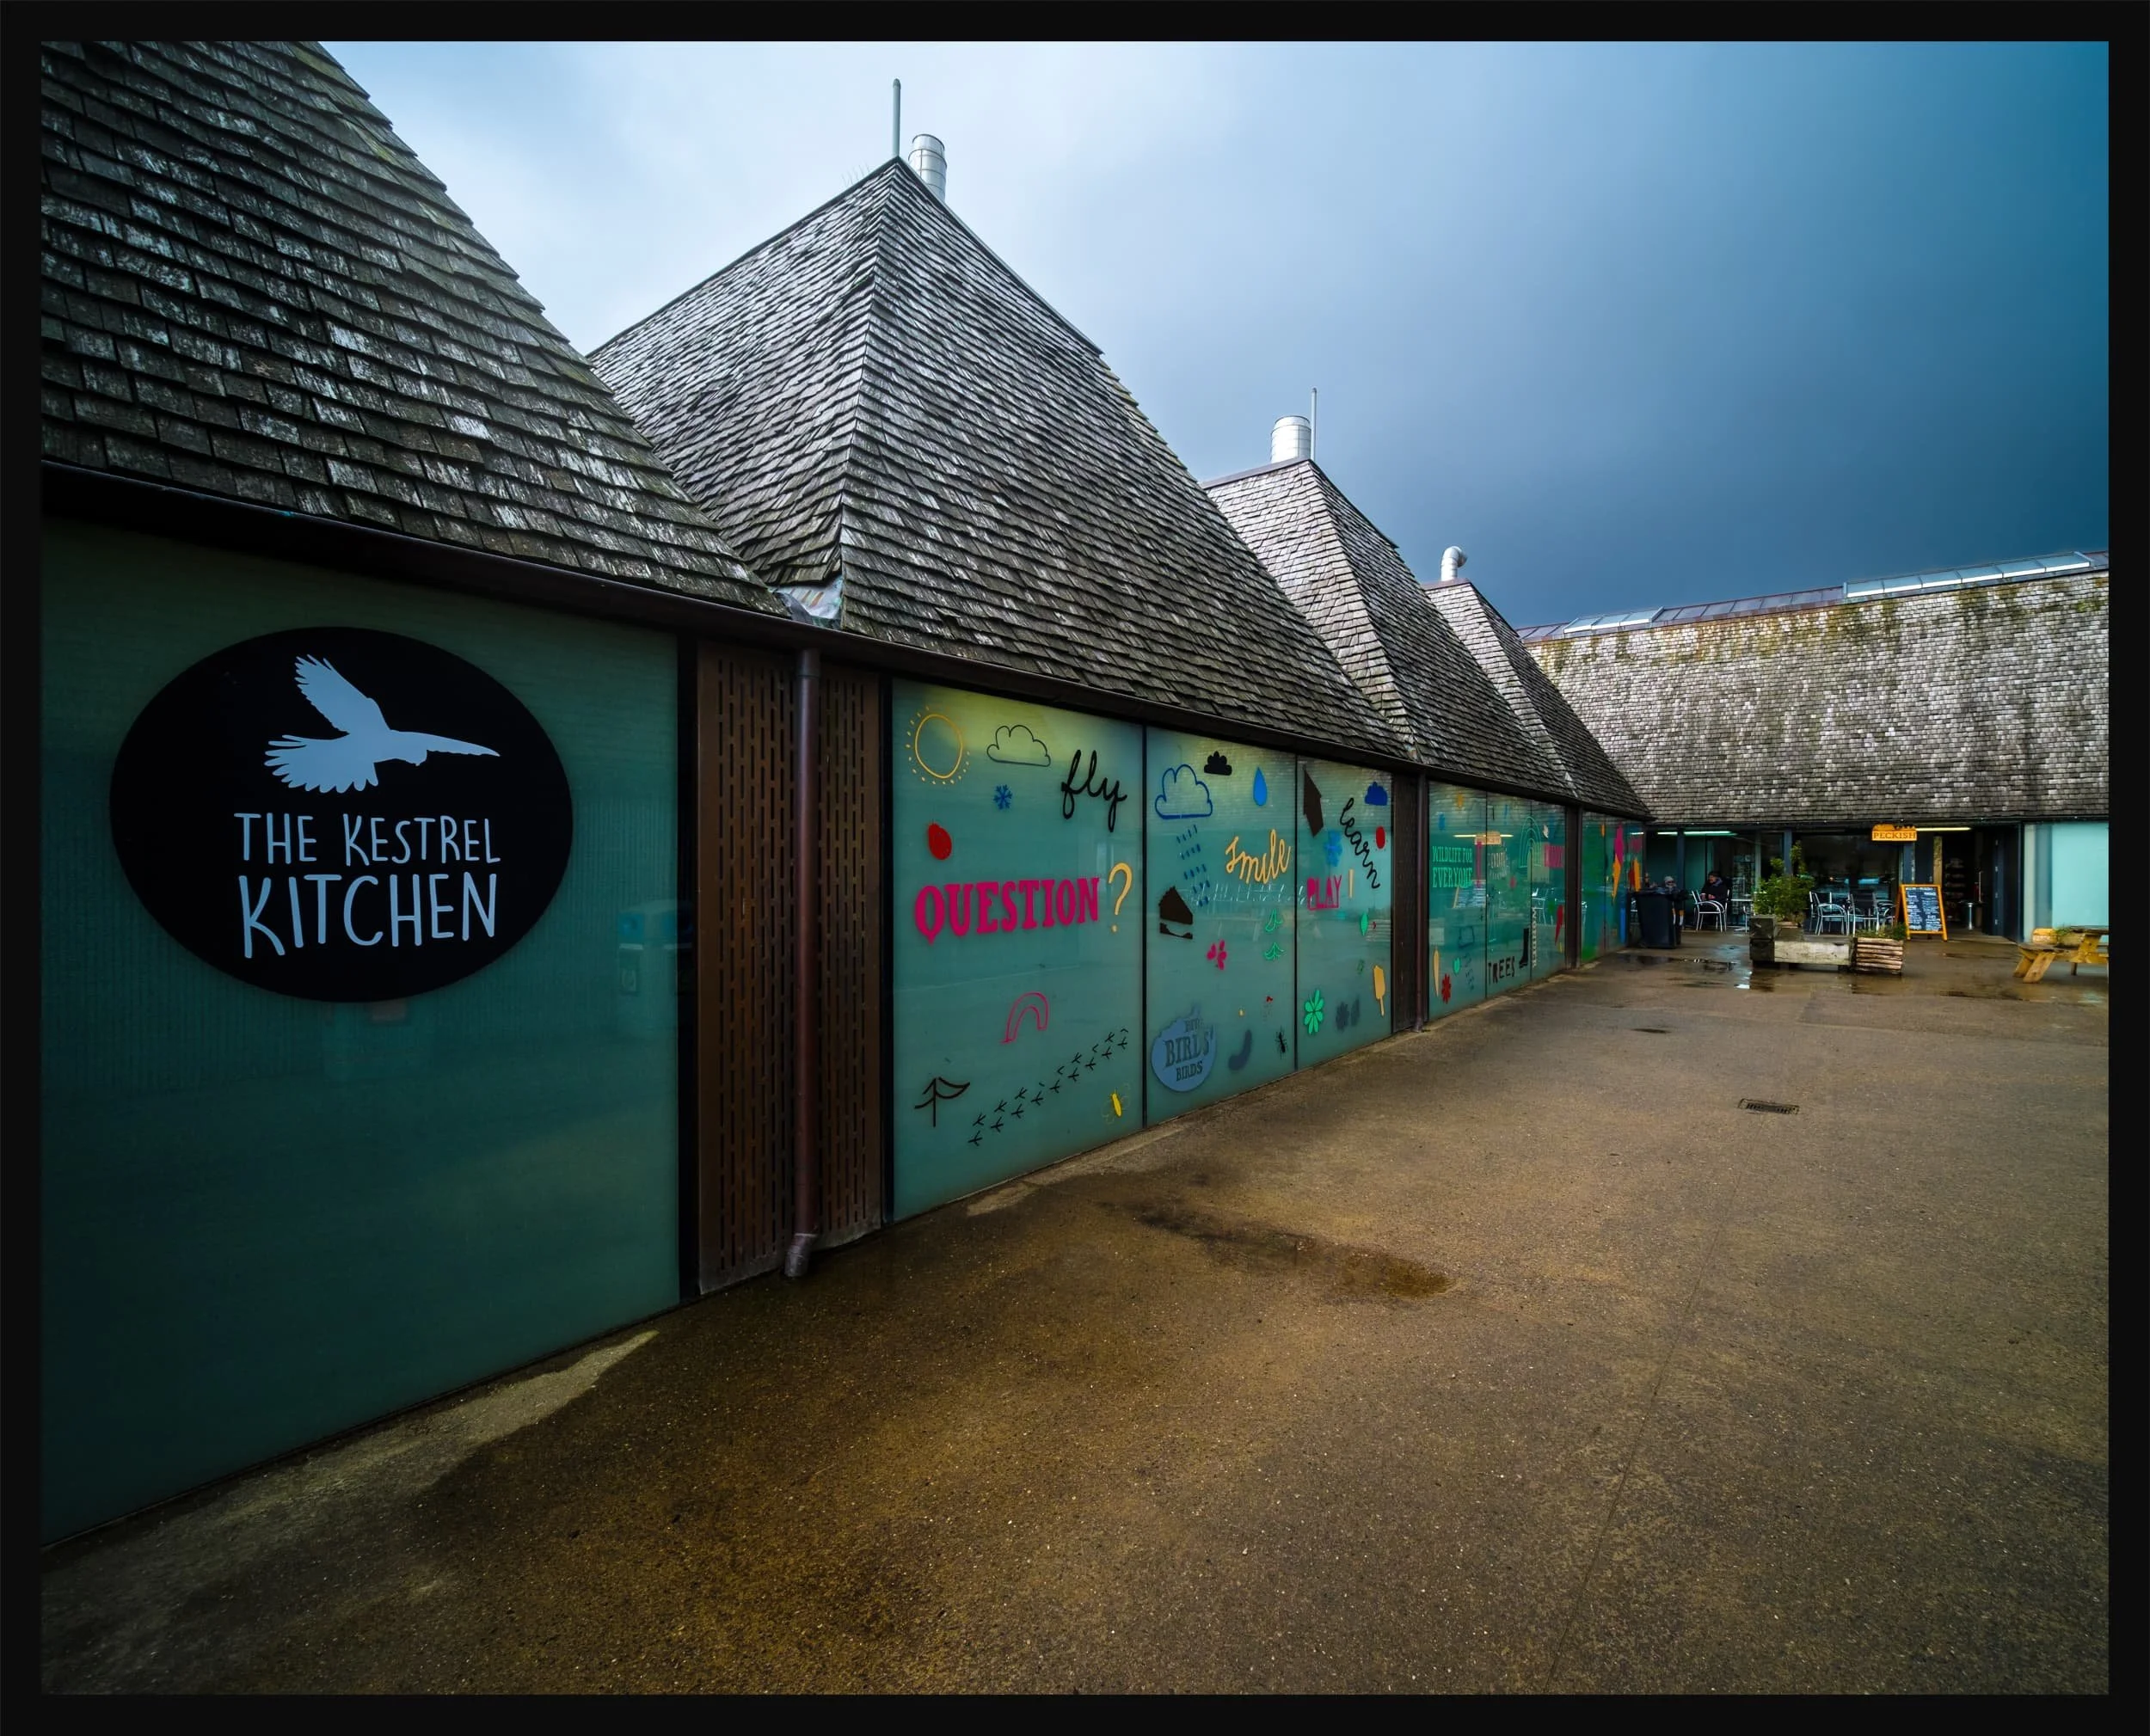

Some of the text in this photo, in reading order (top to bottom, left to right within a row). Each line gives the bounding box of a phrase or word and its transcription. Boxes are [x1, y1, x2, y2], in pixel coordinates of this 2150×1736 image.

[1060, 749, 1127, 832] fly
[234, 813, 501, 866] THE KESTREL
[1340, 797, 1381, 889] learn
[1432, 845, 1462, 863] WILDLIFE
[1462, 847, 1473, 863] FOR
[1432, 867, 1473, 889] EVERYONE
[238, 871, 498, 959] KITCHEN
[1488, 955, 1515, 985] TREES
